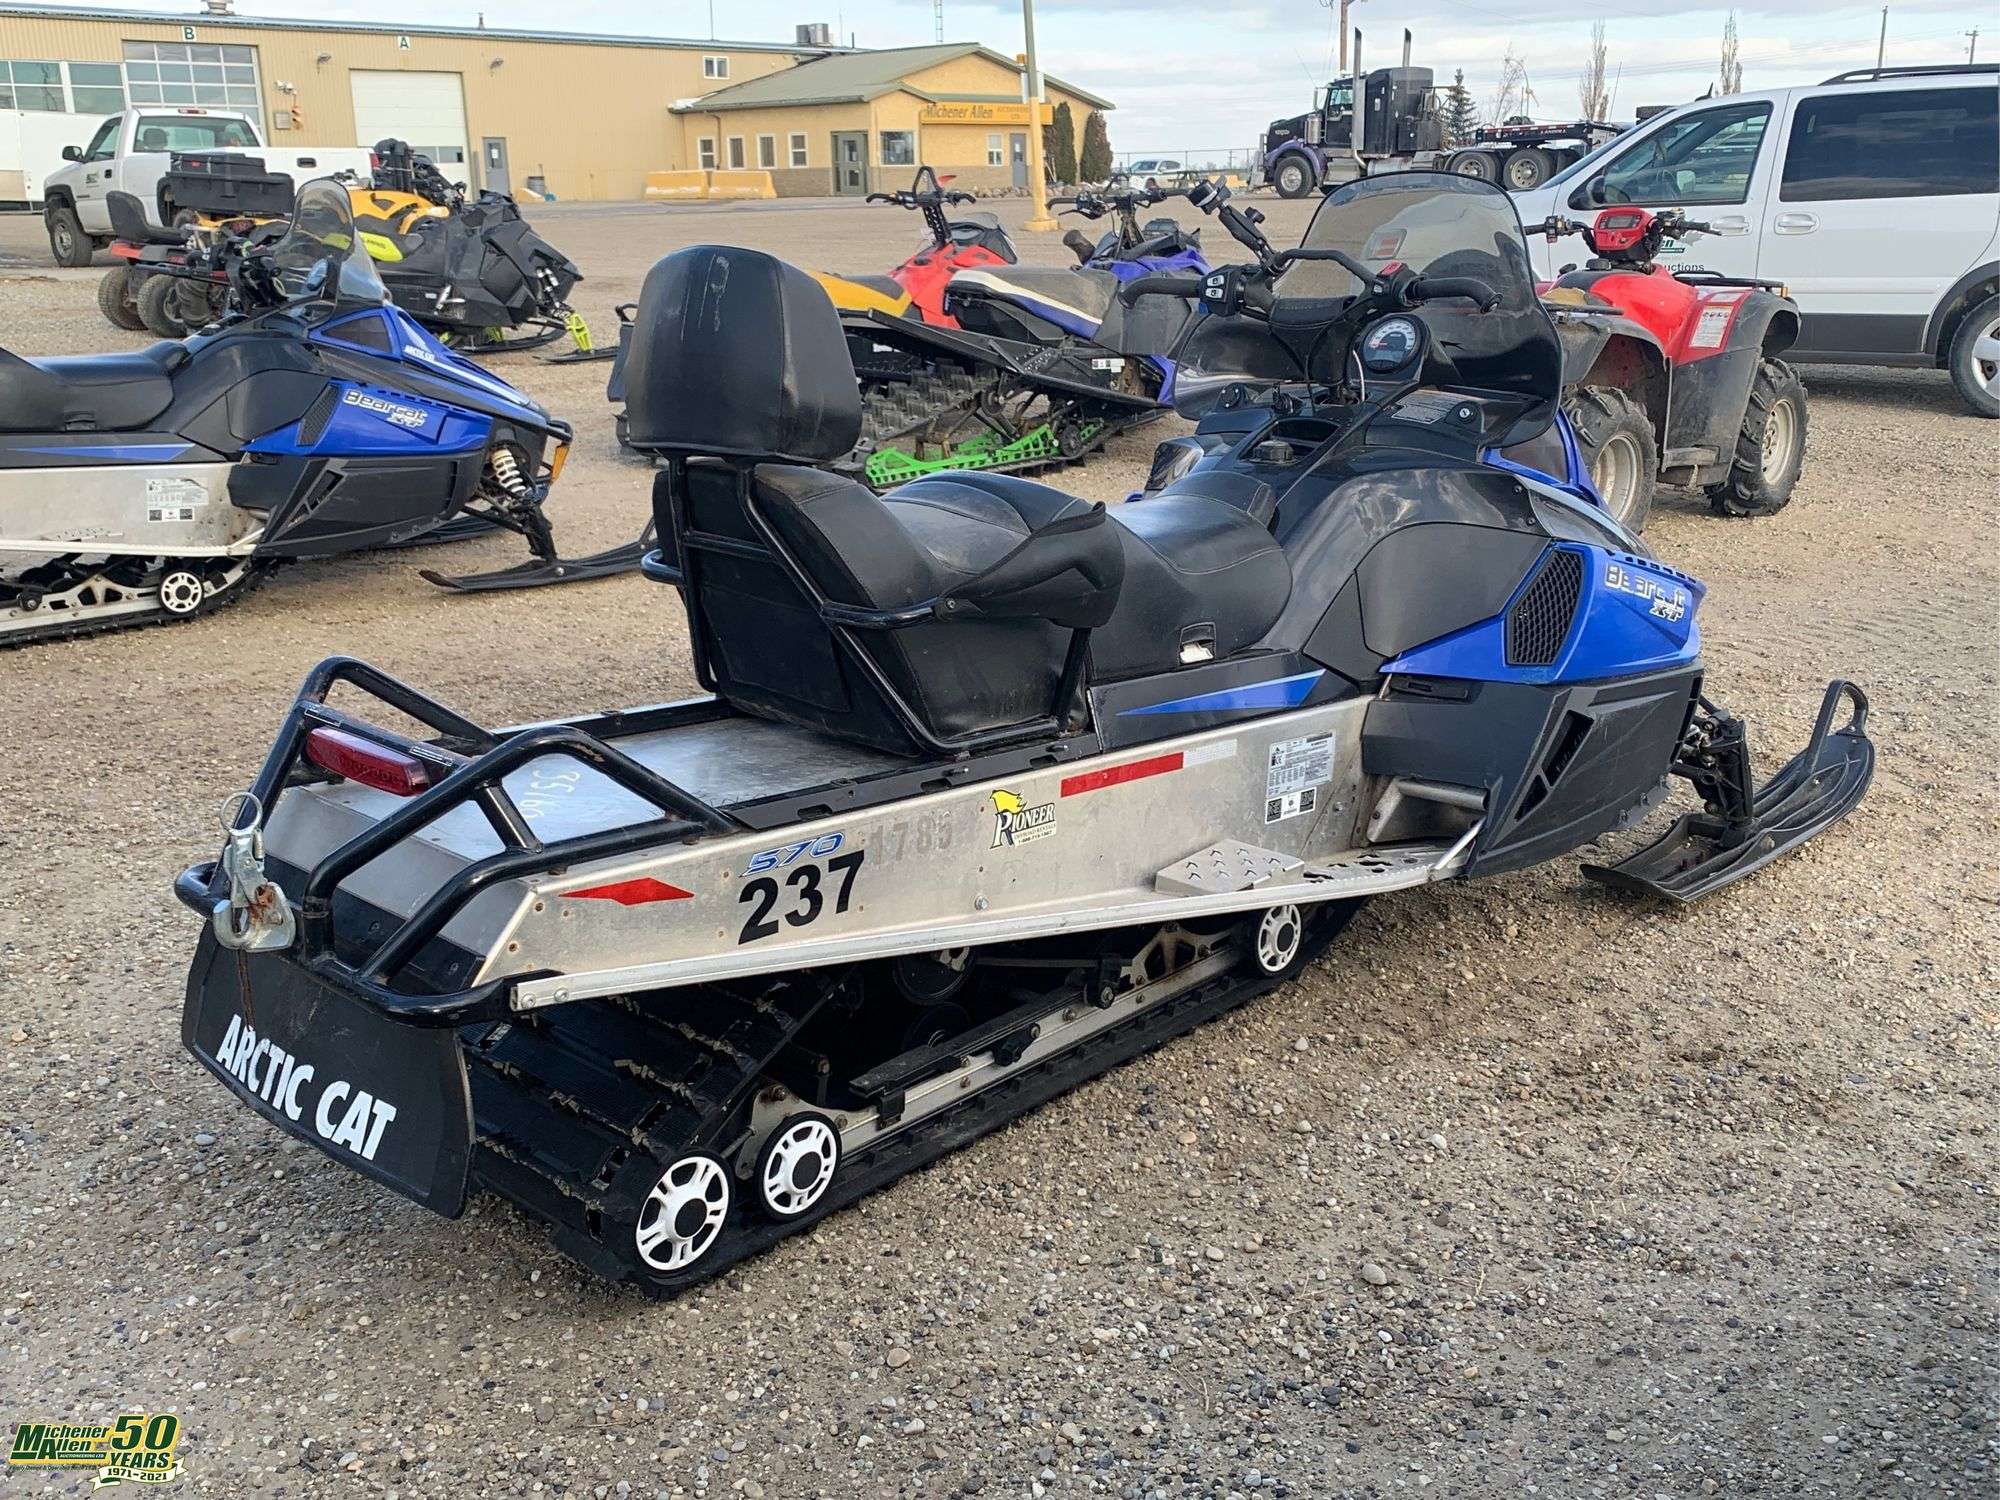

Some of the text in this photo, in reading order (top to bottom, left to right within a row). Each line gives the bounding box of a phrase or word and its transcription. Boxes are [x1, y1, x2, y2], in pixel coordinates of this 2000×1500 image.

[184, 27, 195, 40] B
[399, 37, 409, 49] A
[925, 103, 967, 119] Michener
[970, 104, 993, 119] Allen
[1664, 262, 1705, 272] uctions
[342, 388, 428, 419] Bearcat
[738, 831, 845, 877] 570
[738, 850, 864, 945] 237
[215, 1013, 397, 1161] ARCTIC CAT
